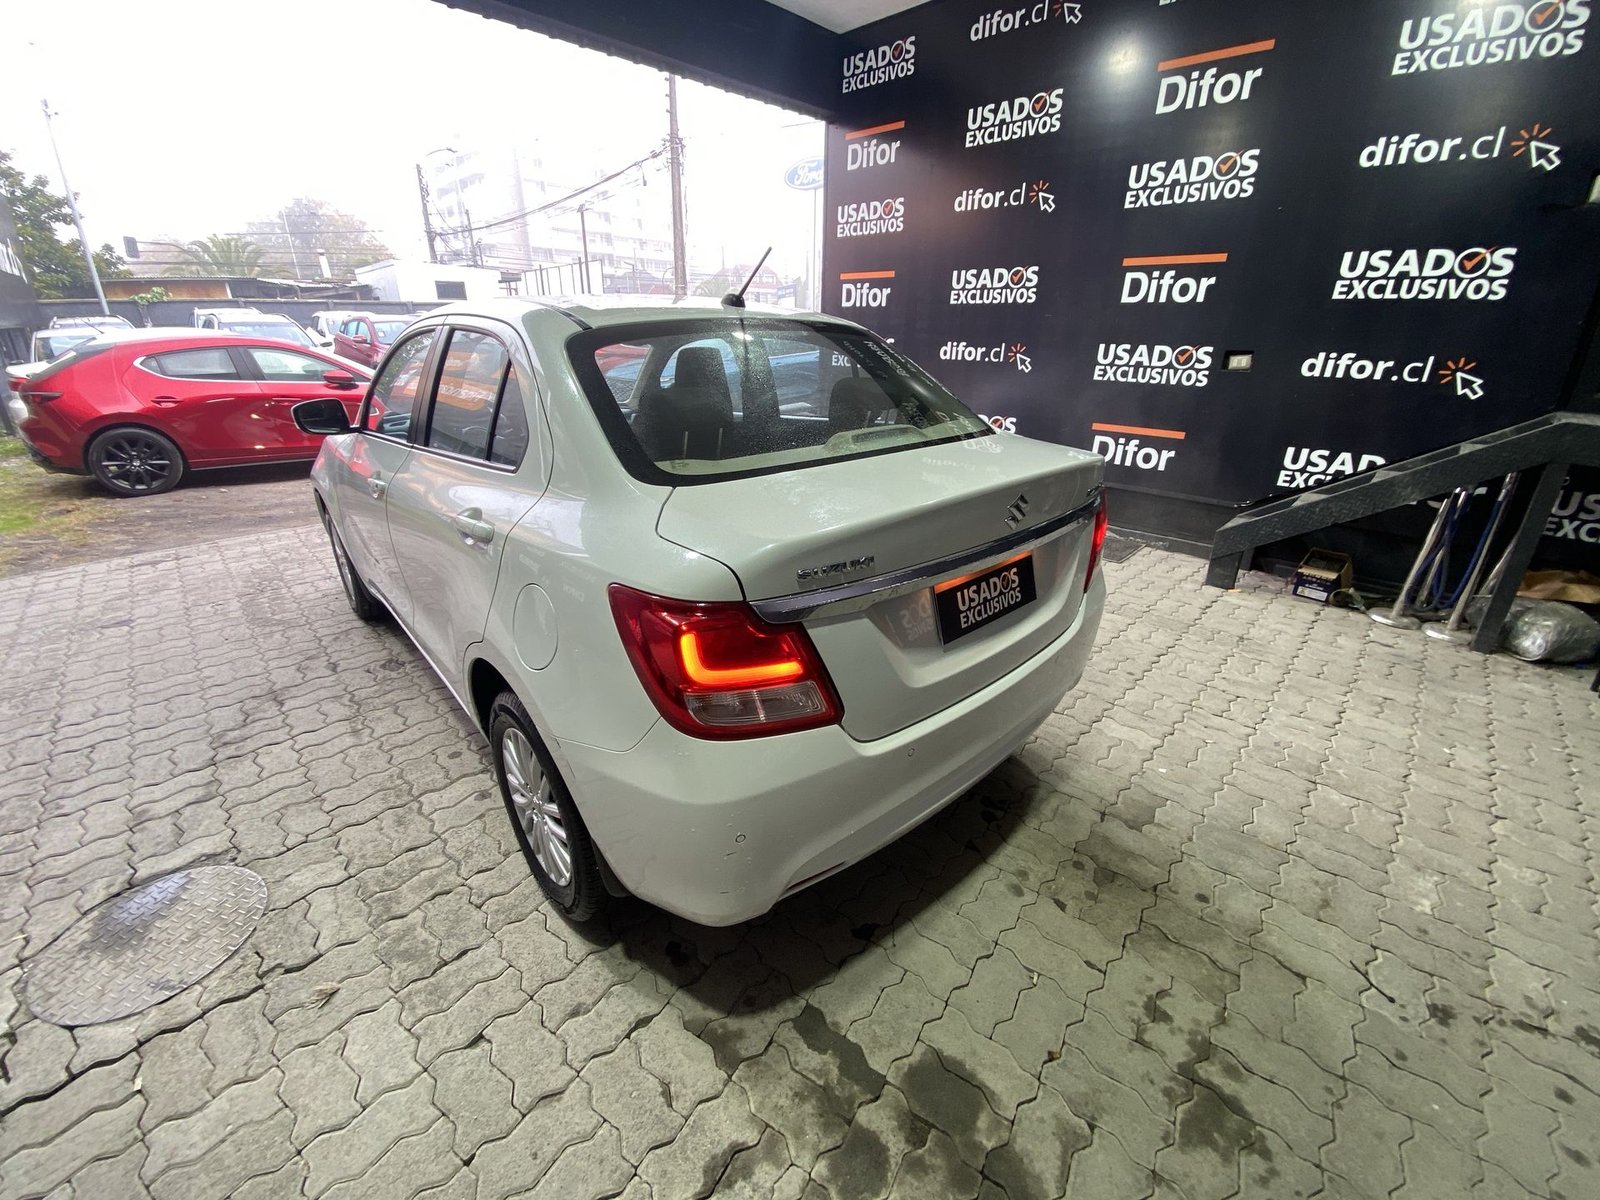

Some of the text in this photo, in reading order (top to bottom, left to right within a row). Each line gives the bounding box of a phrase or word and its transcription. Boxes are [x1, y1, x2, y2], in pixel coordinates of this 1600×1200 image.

[970, 0, 1048, 41] difor.cl
[1400, 0, 1590, 50] USADOS
[844, 36, 915, 77] USADOS
[1391, 30, 1585, 75] EXCLUSIVOS
[842, 59, 915, 94] EXCLUSIVOS
[1155, 67, 1262, 115] Difor
[967, 89, 1063, 130] USADOS
[965, 114, 1061, 148] EXCLUSIVOS
[1359, 126, 1506, 167] difor.cl
[846, 139, 900, 171] Difor
[1128, 149, 1260, 190] USADOS
[954, 183, 1026, 212] difor.cl
[1124, 178, 1255, 209] EXCLUSIVOS
[837, 197, 904, 223] USADOS
[837, 218, 904, 238] EXCLUSIVOS
[951, 265, 1039, 289] USADOS
[1339, 247, 1517, 279] USADOS
[841, 282, 890, 308] Difor
[950, 287, 1037, 305] EXCLUSIVOS
[1121, 270, 1216, 303] Difor
[1332, 279, 1509, 300] EXCLUSIVOS
[940, 342, 1005, 362] difor.cl
[1097, 343, 1214, 369] USADOS
[1300, 352, 1435, 382] difor.cl
[1093, 365, 1209, 387] EXCLUSIVOS
[1091, 435, 1175, 471] Difor
[797, 556, 875, 580] SUZUKI
[957, 567, 1019, 611] USADOS
[960, 587, 1021, 629] EXCLUSIVOS
